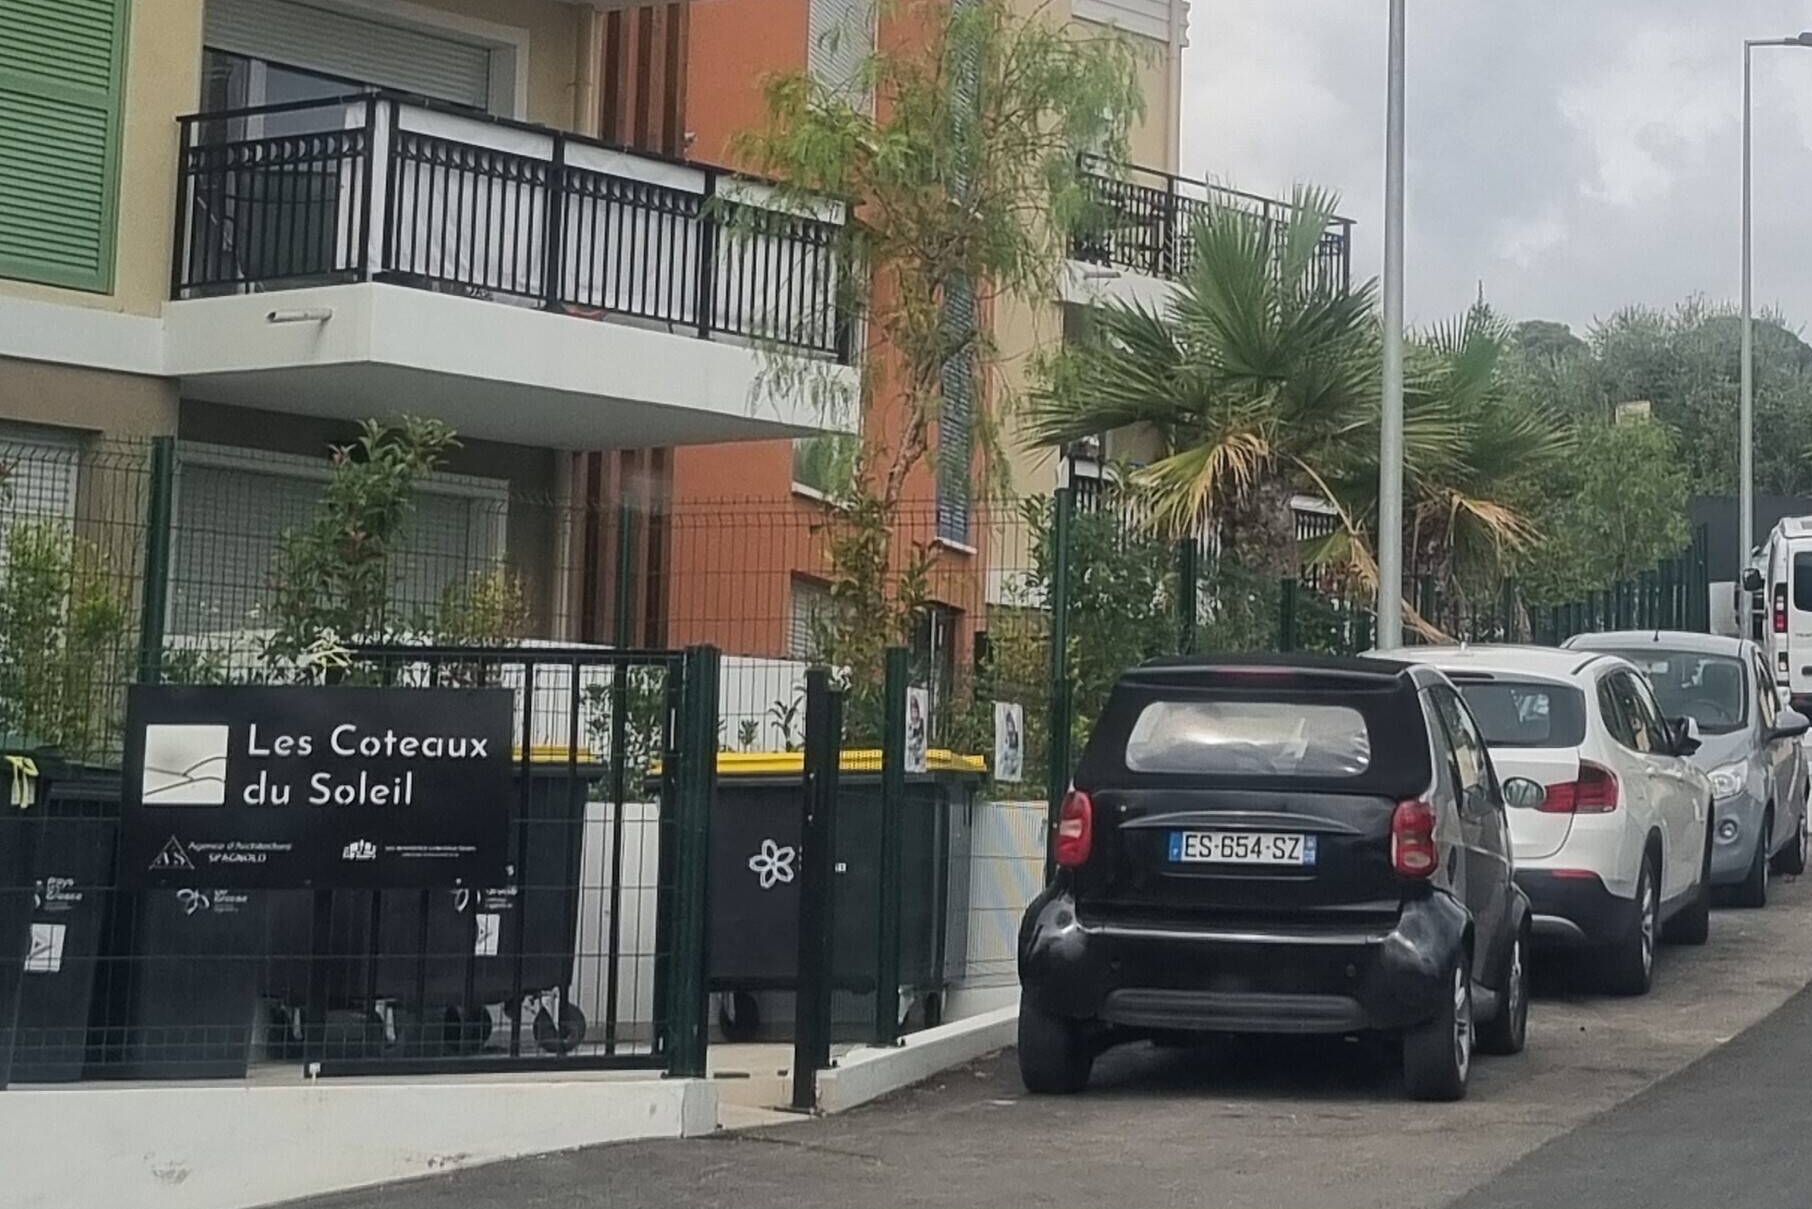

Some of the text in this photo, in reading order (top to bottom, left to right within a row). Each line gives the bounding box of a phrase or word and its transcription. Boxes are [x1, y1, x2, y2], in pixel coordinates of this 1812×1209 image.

[248, 723, 489, 758] Les Coteaux
[242, 769, 413, 806] du Soleil
[1184, 834, 1301, 860] ES-654-SZ
